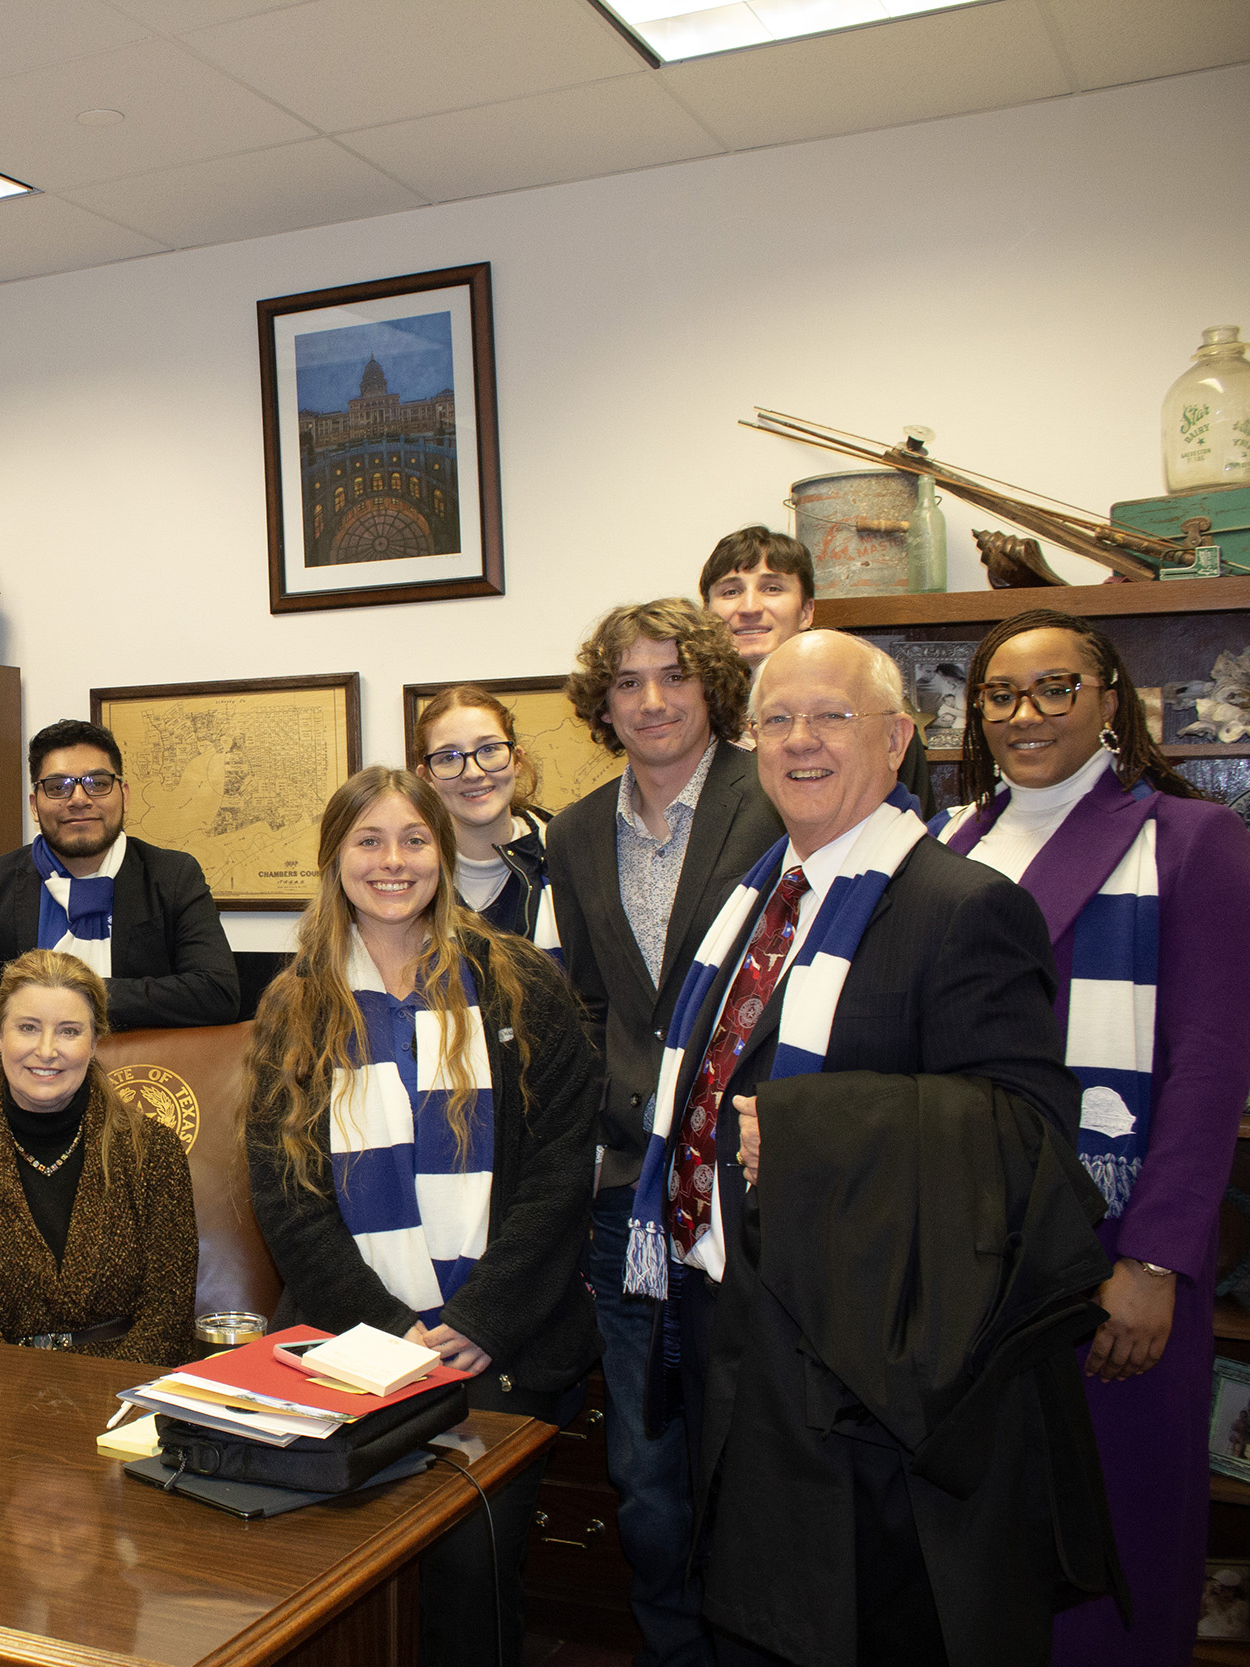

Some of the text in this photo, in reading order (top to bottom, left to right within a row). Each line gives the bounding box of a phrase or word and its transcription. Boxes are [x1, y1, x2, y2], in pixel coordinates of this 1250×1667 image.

[1180, 404, 1210, 434] Star
[1184, 423, 1210, 444] DAIRY
[108, 1068, 196, 1143] ATE OF TEXAS
